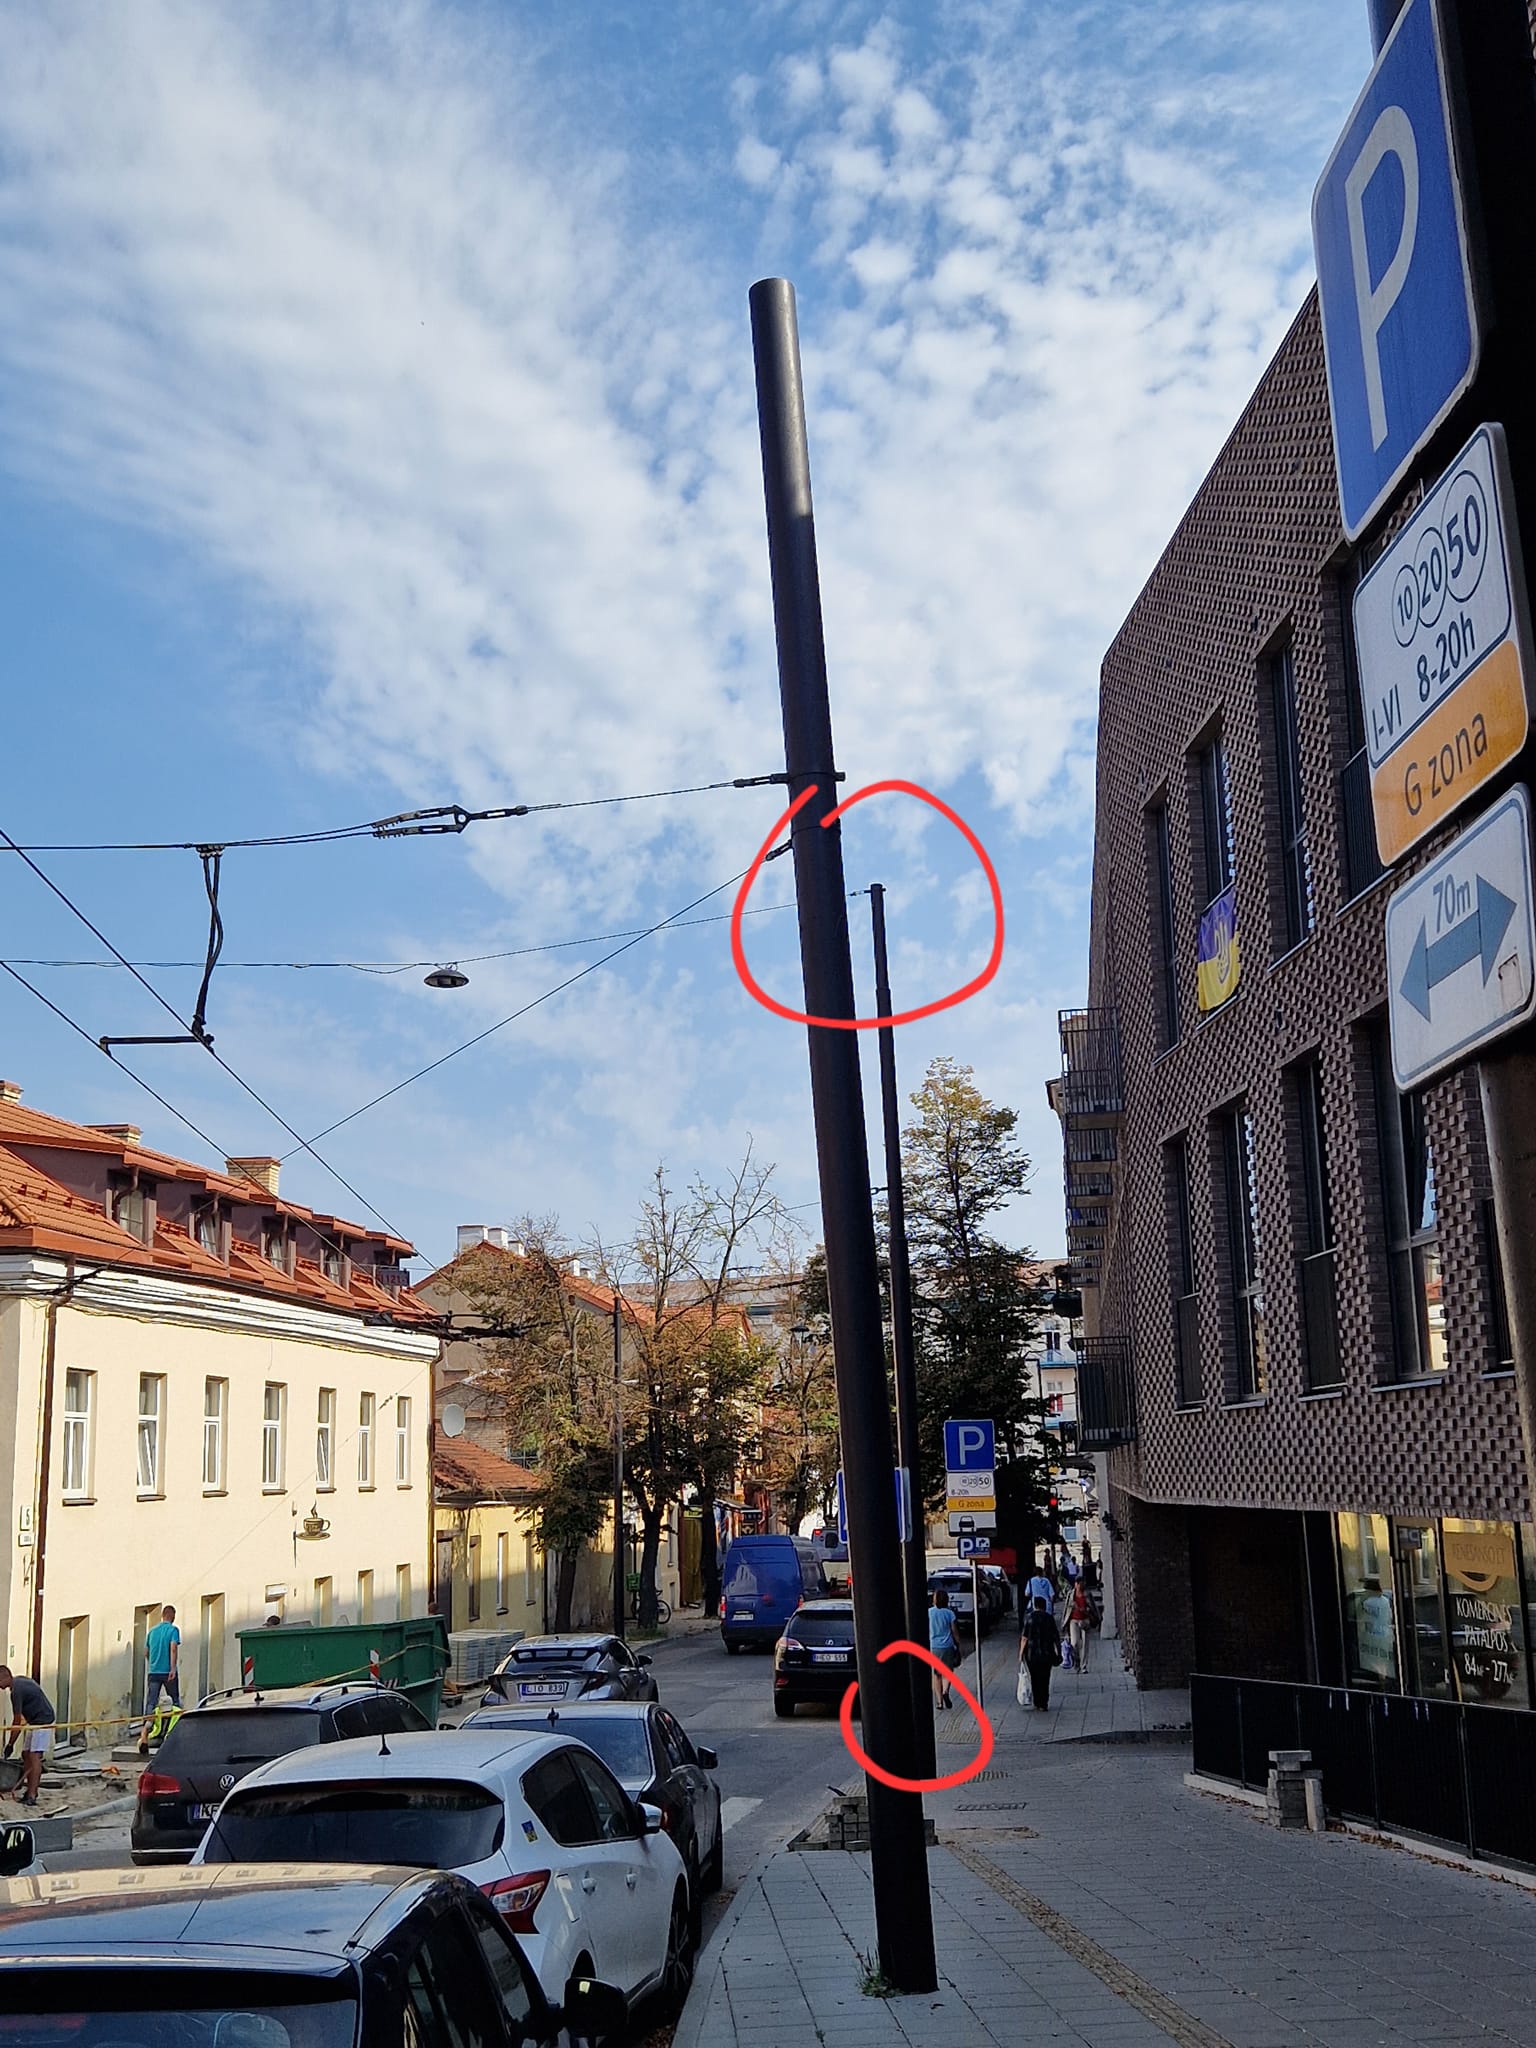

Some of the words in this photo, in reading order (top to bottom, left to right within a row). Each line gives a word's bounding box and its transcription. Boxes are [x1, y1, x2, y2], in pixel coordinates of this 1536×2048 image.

[1345, 105, 1419, 452] P
[1397, 585, 1413, 626] 10
[1419, 547, 1442, 608] 20
[1446, 495, 1481, 579] 50
[1372, 683, 1402, 750] I-VI
[1417, 611, 1476, 702] 8-20h
[1404, 762, 1423, 816] G
[1428, 712, 1488, 799] zona
[1433, 874, 1471, 934] 70m
[958, 1426, 985, 1465] P
[979, 1477, 990, 1485] 50
[958, 1500, 965, 1508] G
[960, 1538, 974, 1558] P
[1464, 1625, 1508, 1653] PATALPOS
[526, 1684, 544, 1693] LIO
